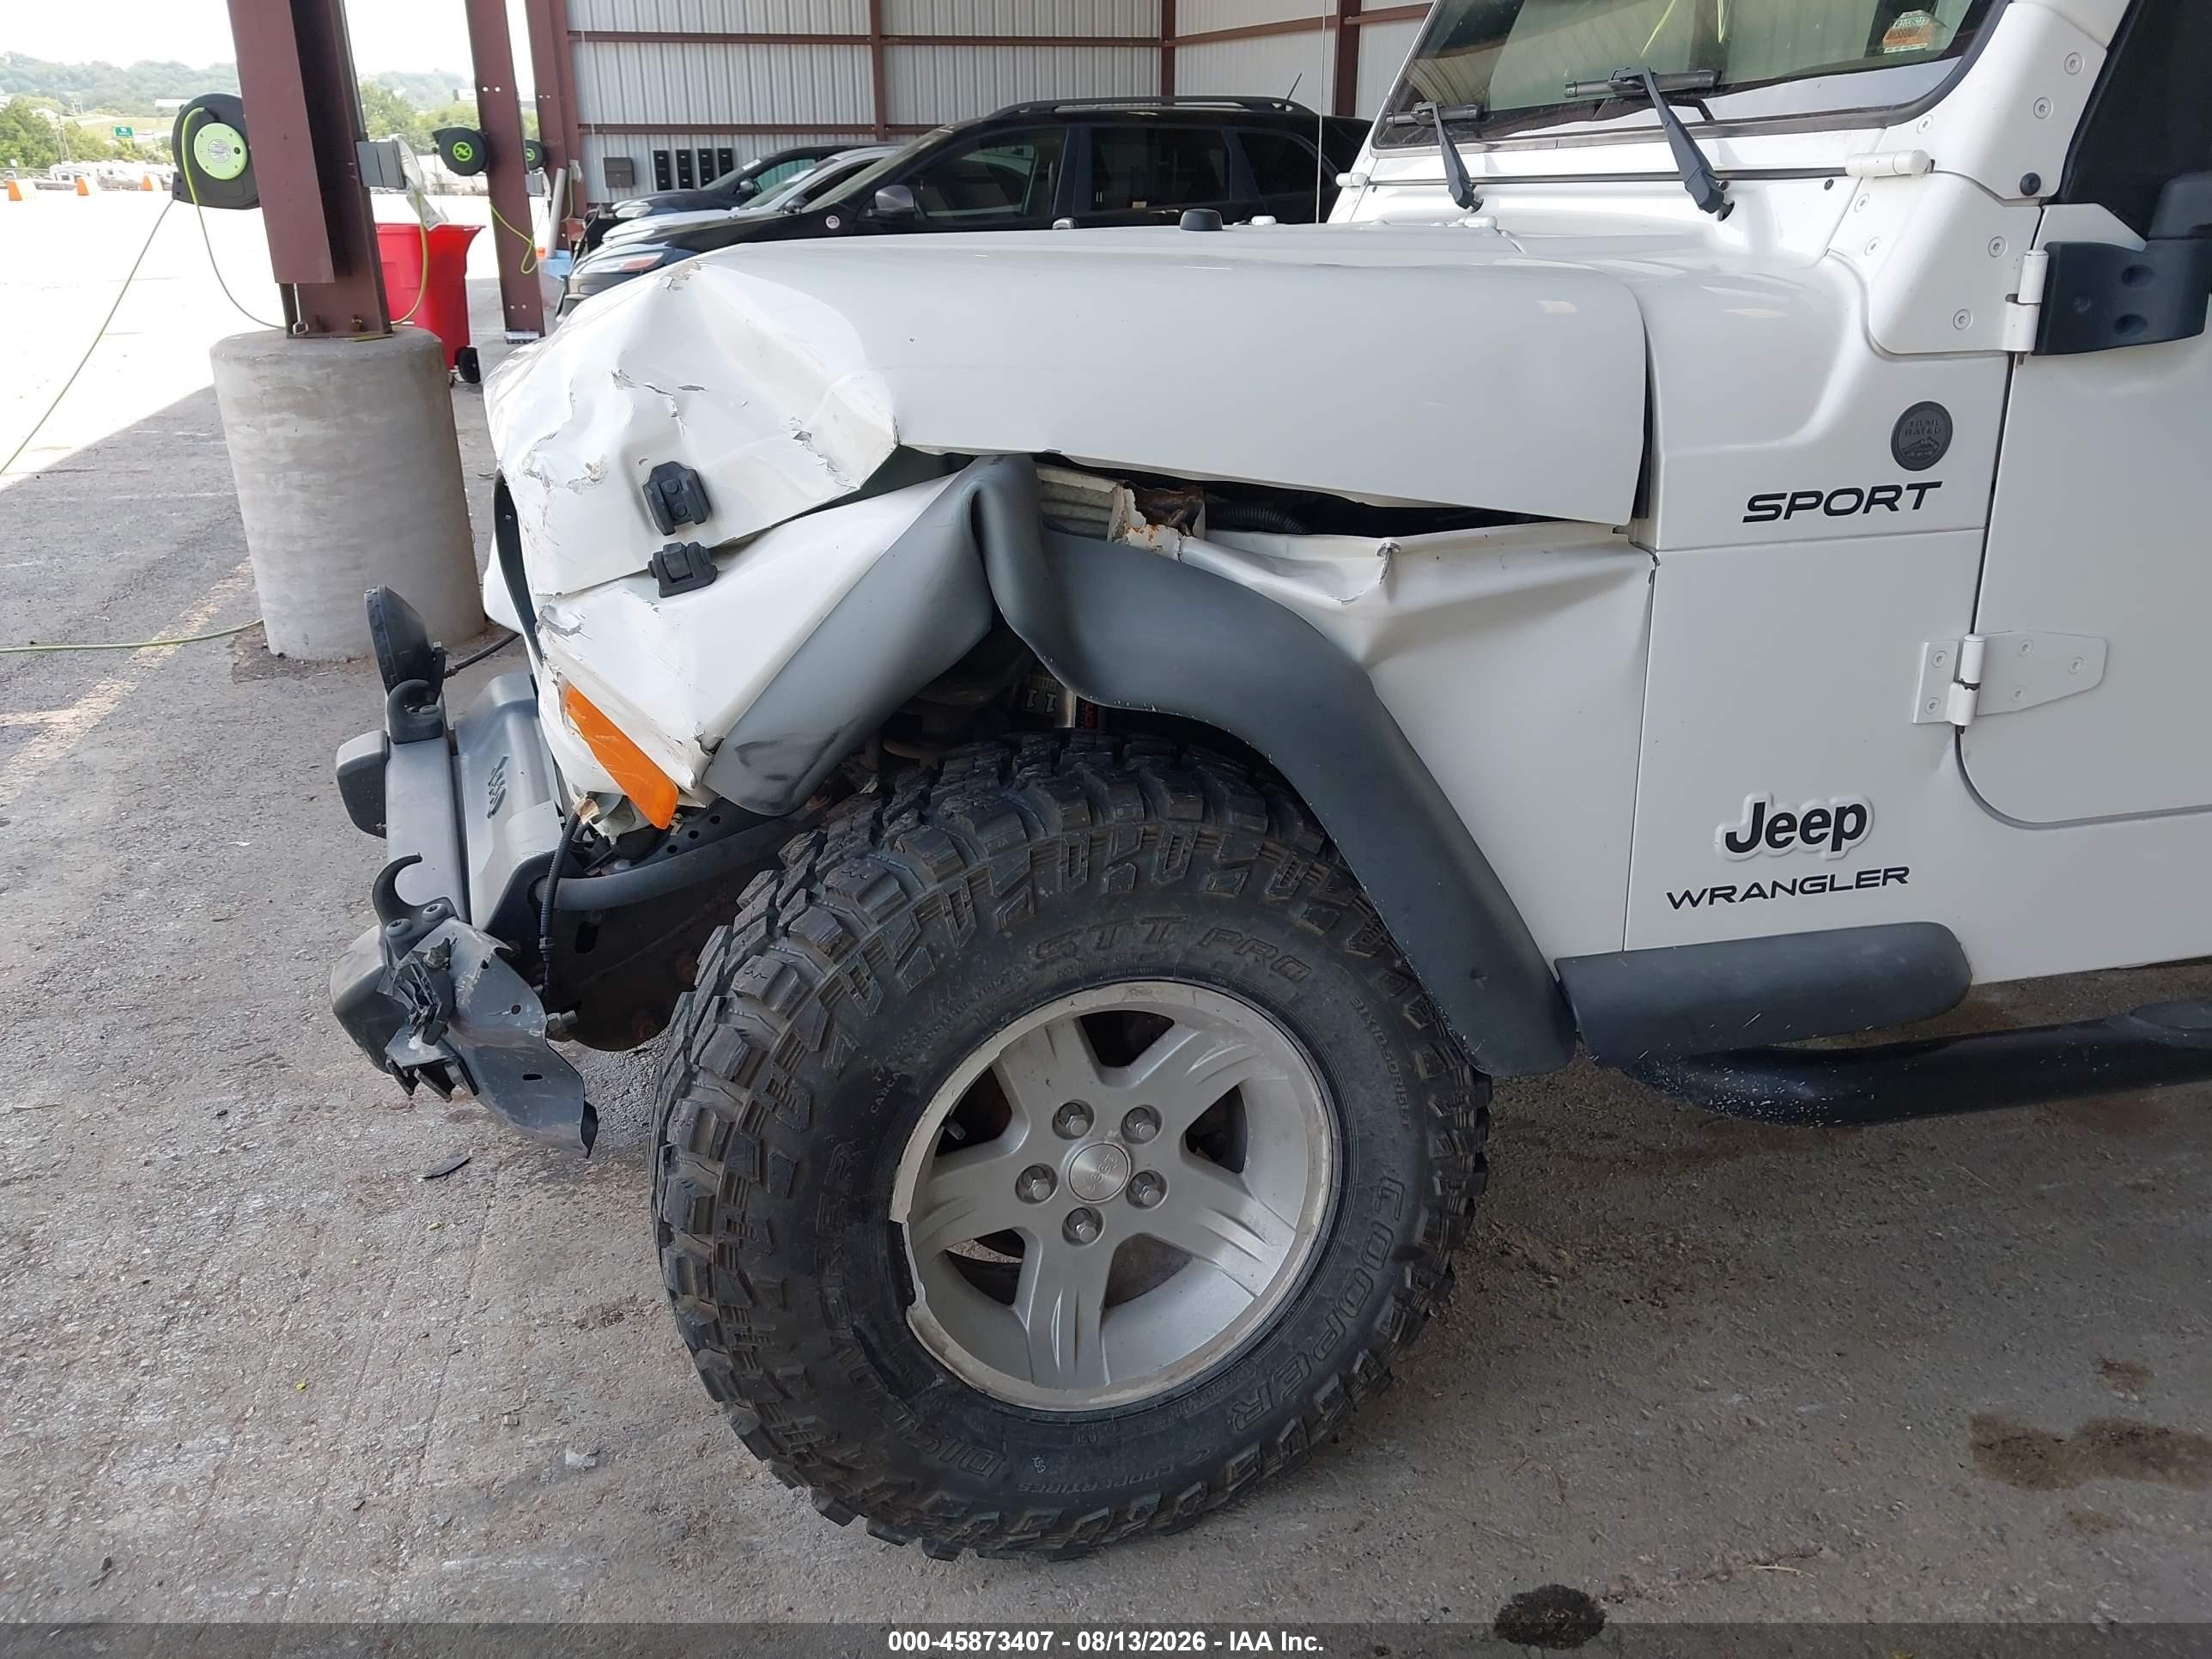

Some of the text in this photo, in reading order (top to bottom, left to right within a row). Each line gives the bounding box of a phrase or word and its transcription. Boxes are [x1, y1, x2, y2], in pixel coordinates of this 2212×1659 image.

[1905, 427, 1942, 436] RATED
[1742, 481, 1943, 523] SPORT
[1724, 800, 1868, 854] Jeep
[1666, 866, 1910, 910] WRANGLER
[1035, 915, 1314, 983] STT PRO
[1231, 1175, 1407, 1431] COOPER
